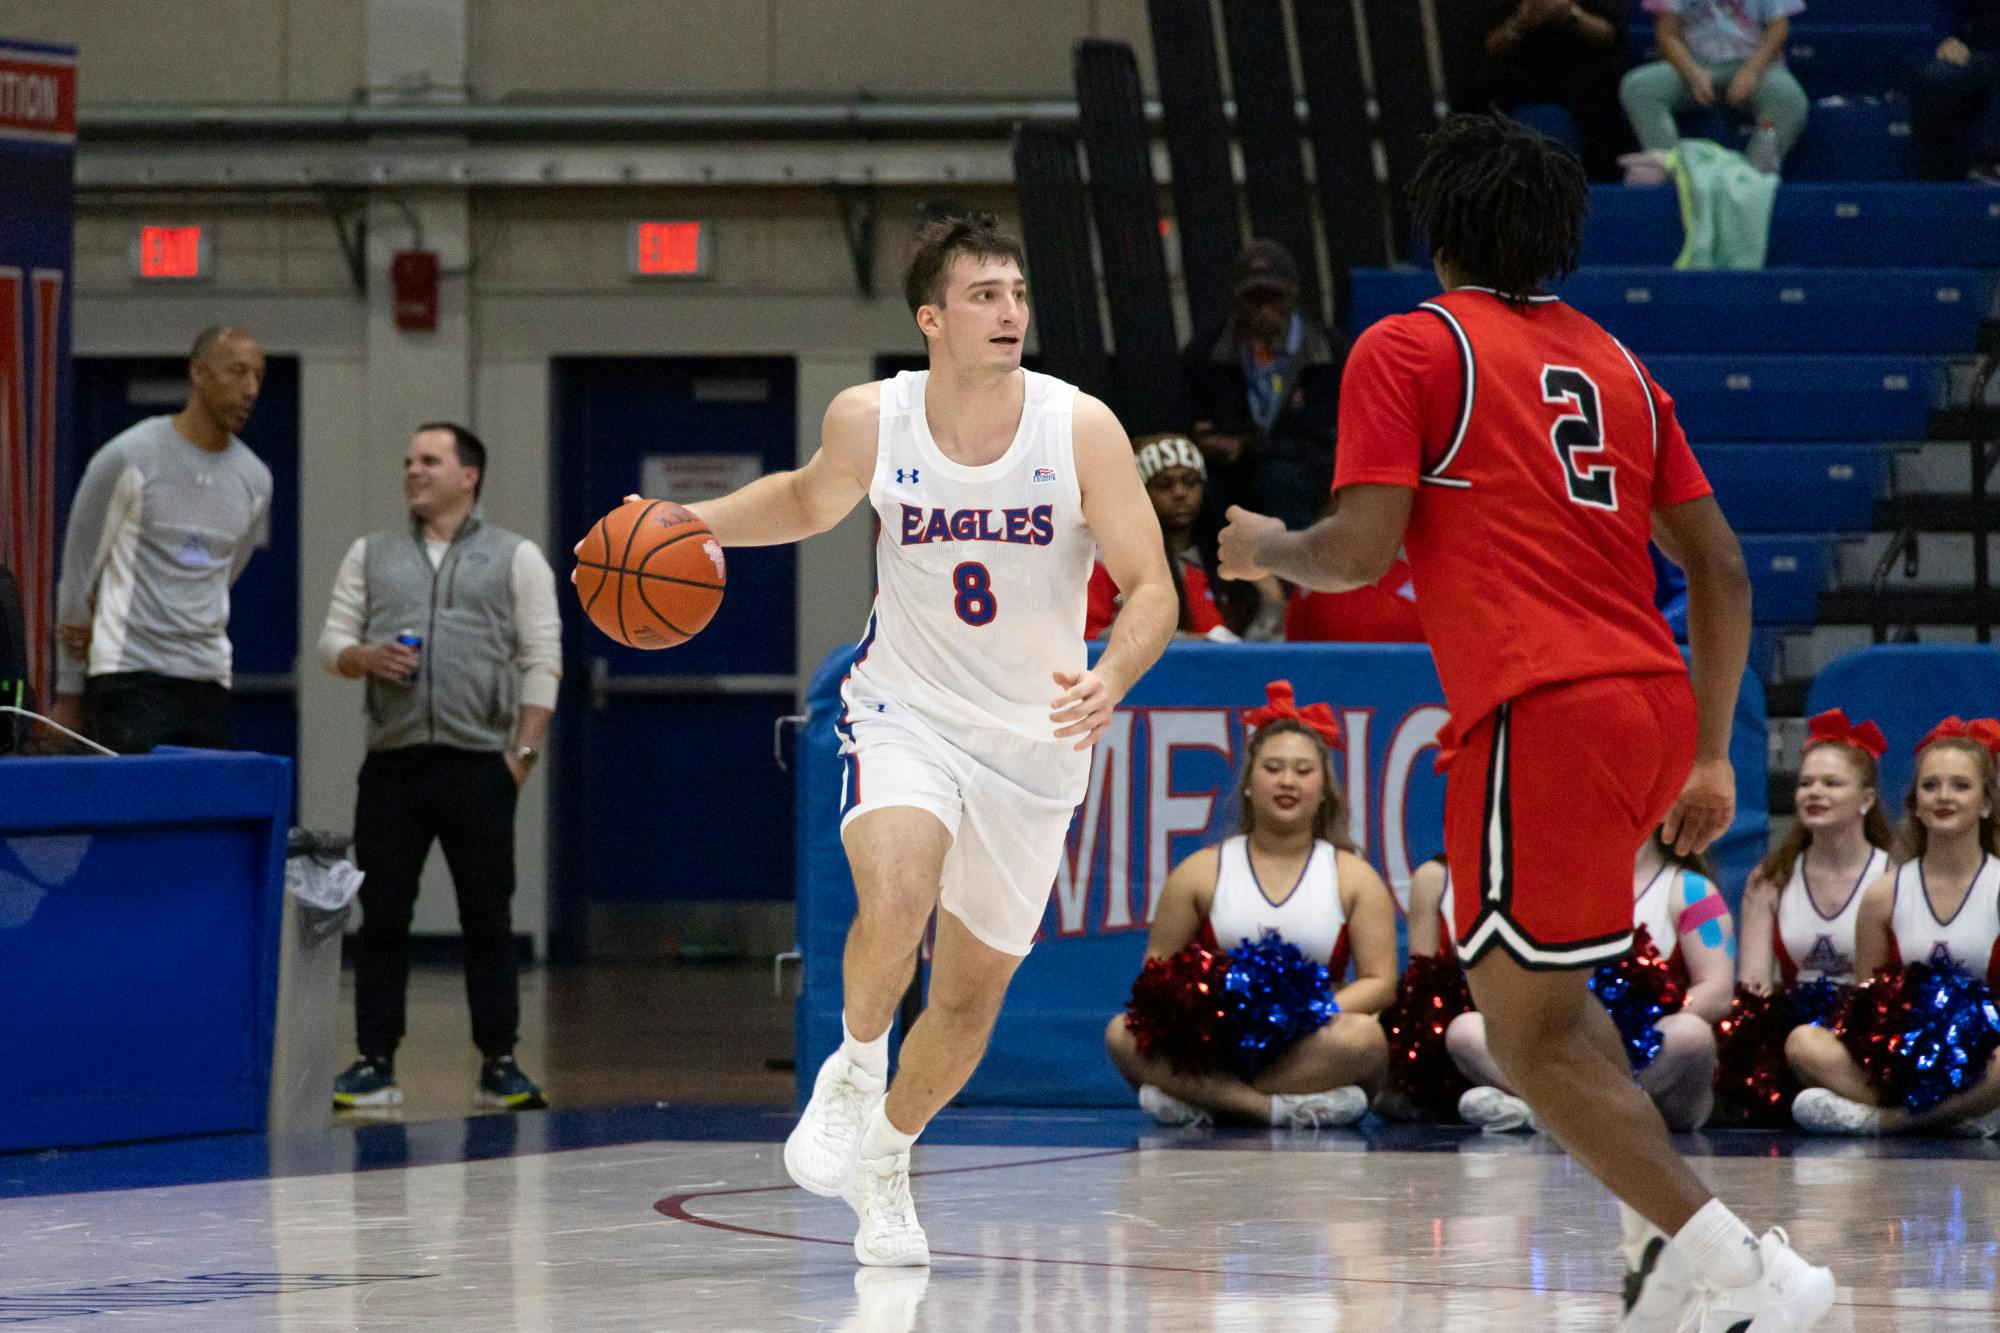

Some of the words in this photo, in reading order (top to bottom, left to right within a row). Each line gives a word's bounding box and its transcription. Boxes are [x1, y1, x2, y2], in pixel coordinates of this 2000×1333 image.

[1540, 363, 1619, 512] 2
[899, 503, 1054, 546] EAGLES
[952, 561, 997, 627] 8
